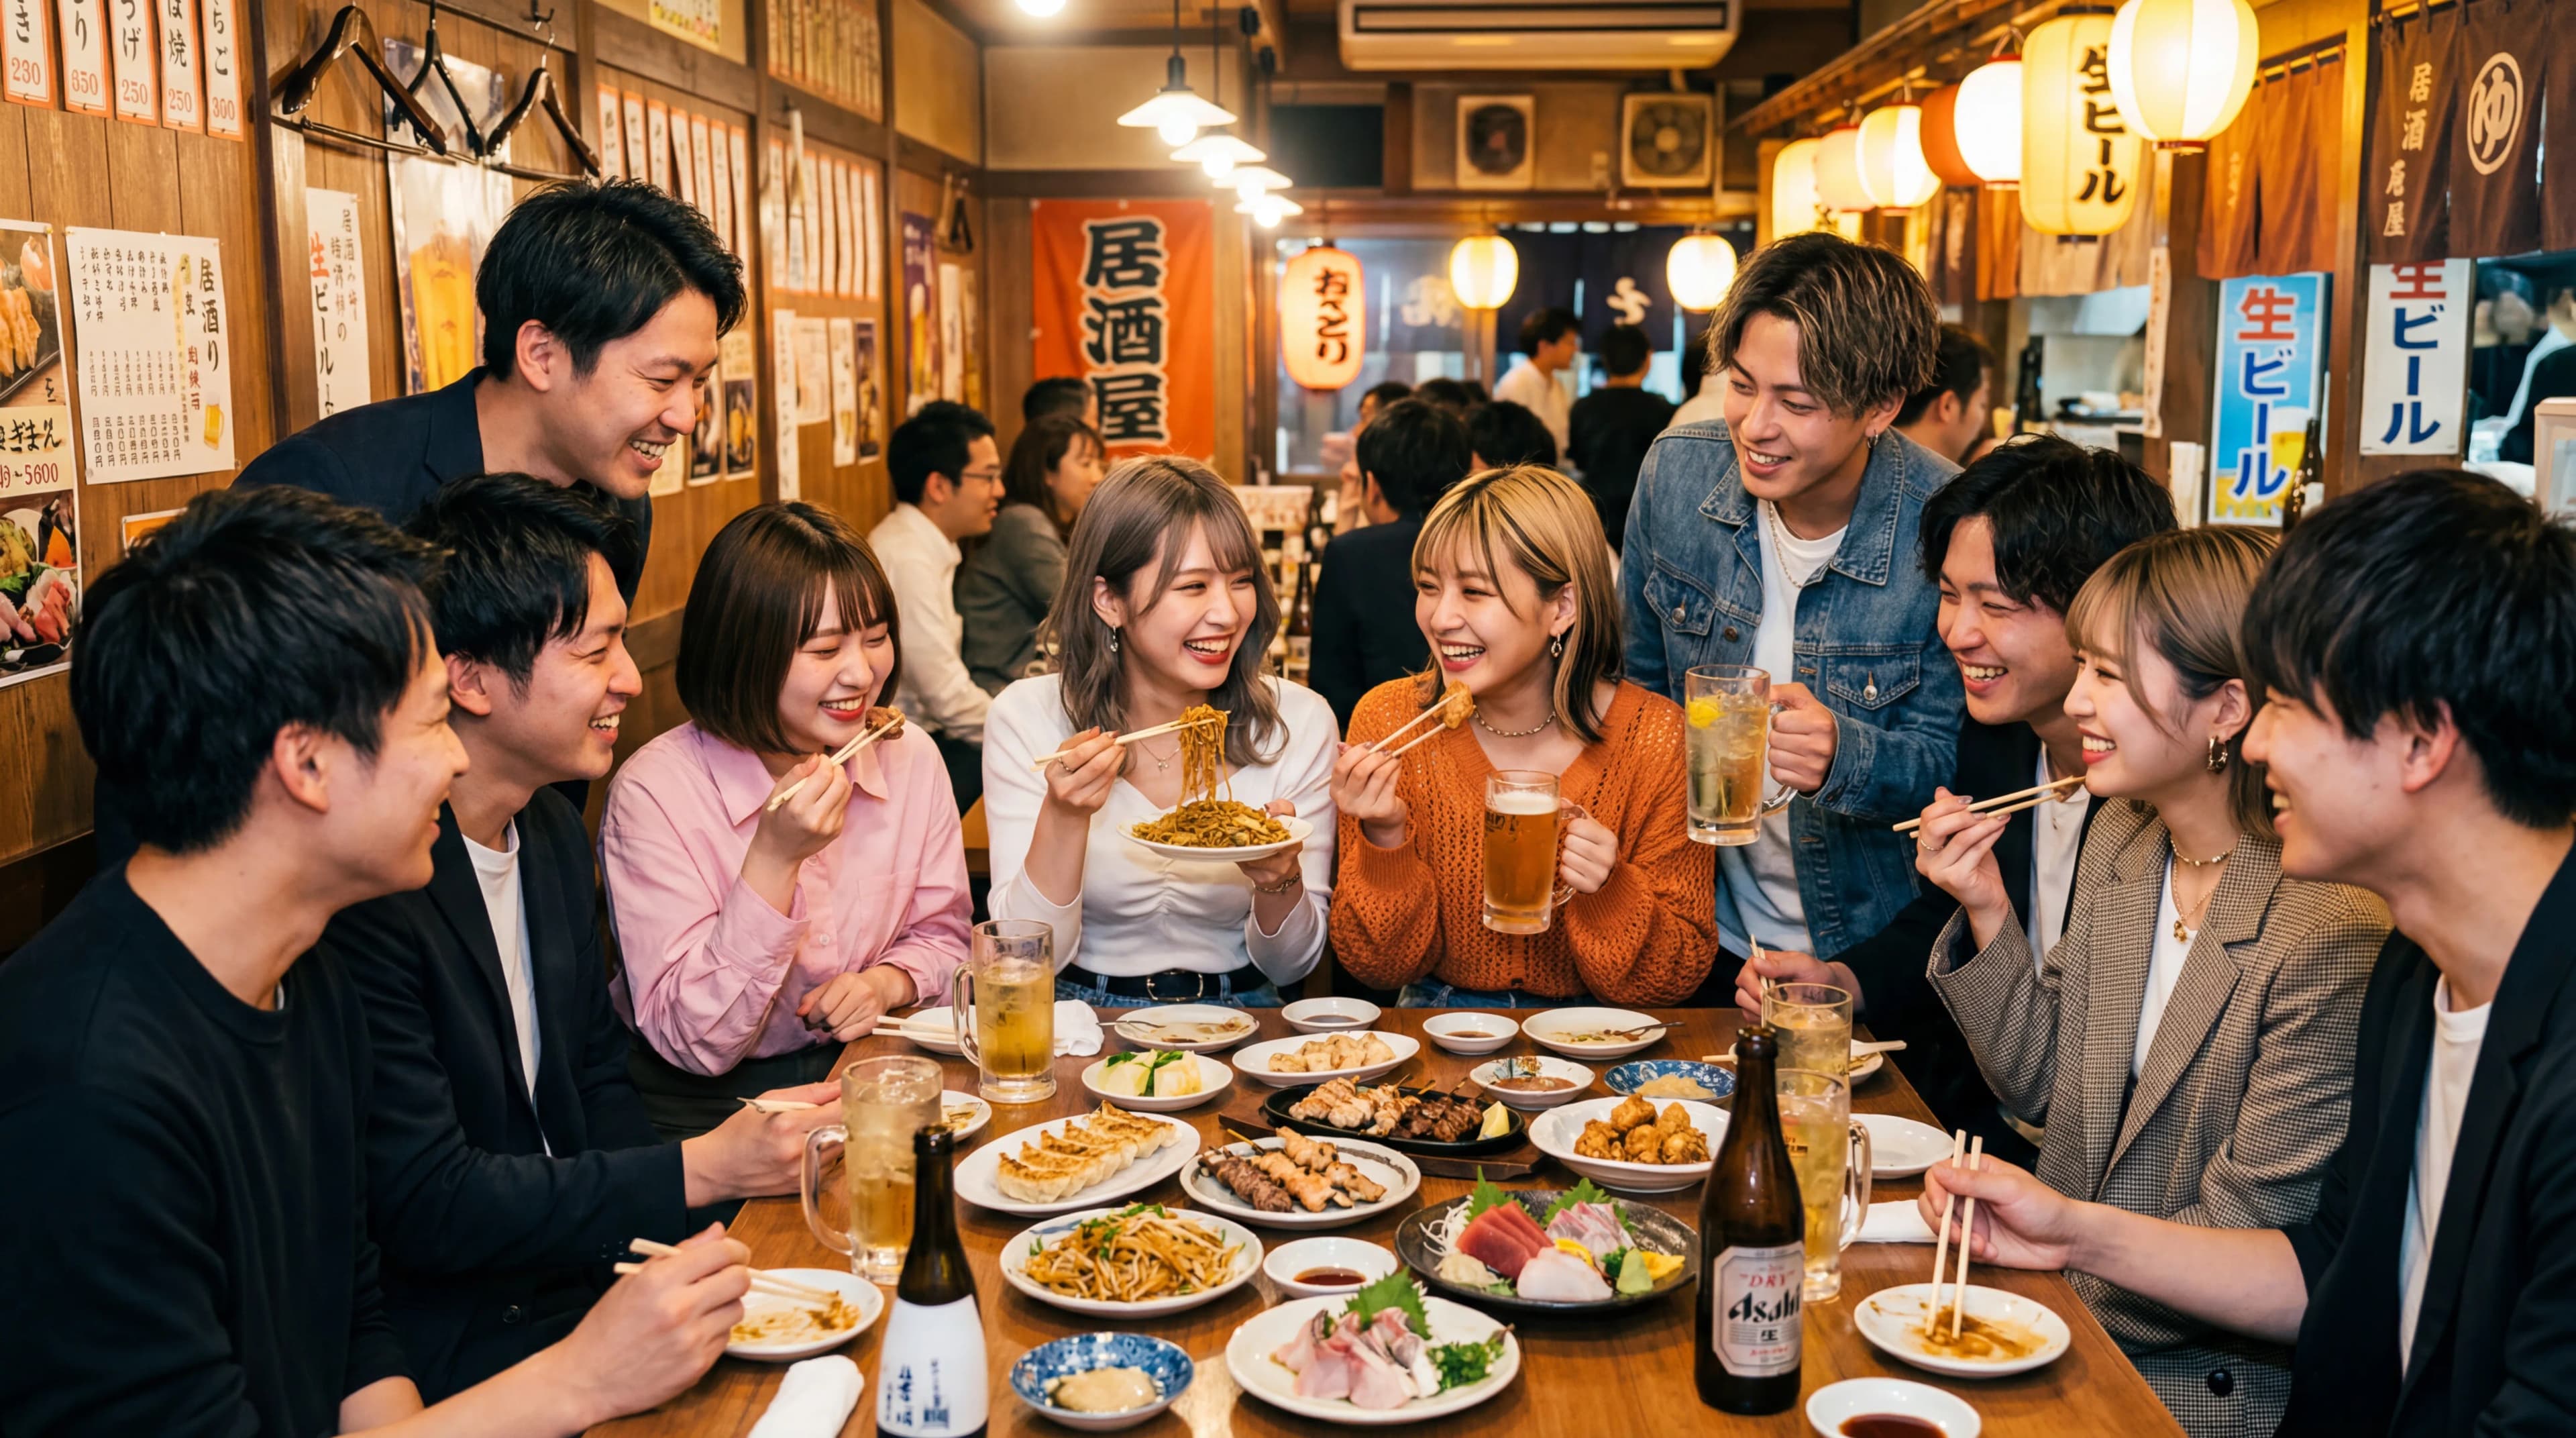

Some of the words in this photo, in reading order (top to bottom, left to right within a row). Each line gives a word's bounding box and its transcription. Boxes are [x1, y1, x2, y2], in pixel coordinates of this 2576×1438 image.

[74, 0, 87, 51] り
[11, 57, 41, 85] 230
[121, 79, 148, 105] 250
[168, 89, 193, 113] 250
[212, 97, 235, 120] 300
[1081, 218, 1168, 443] 居酒屋
[2380, 259, 2447, 444] 生ビール
[2233, 288, 2295, 497] 生ビール
[1729, 1282, 1801, 1323] Asahi
[1762, 1329, 1779, 1341] 生
